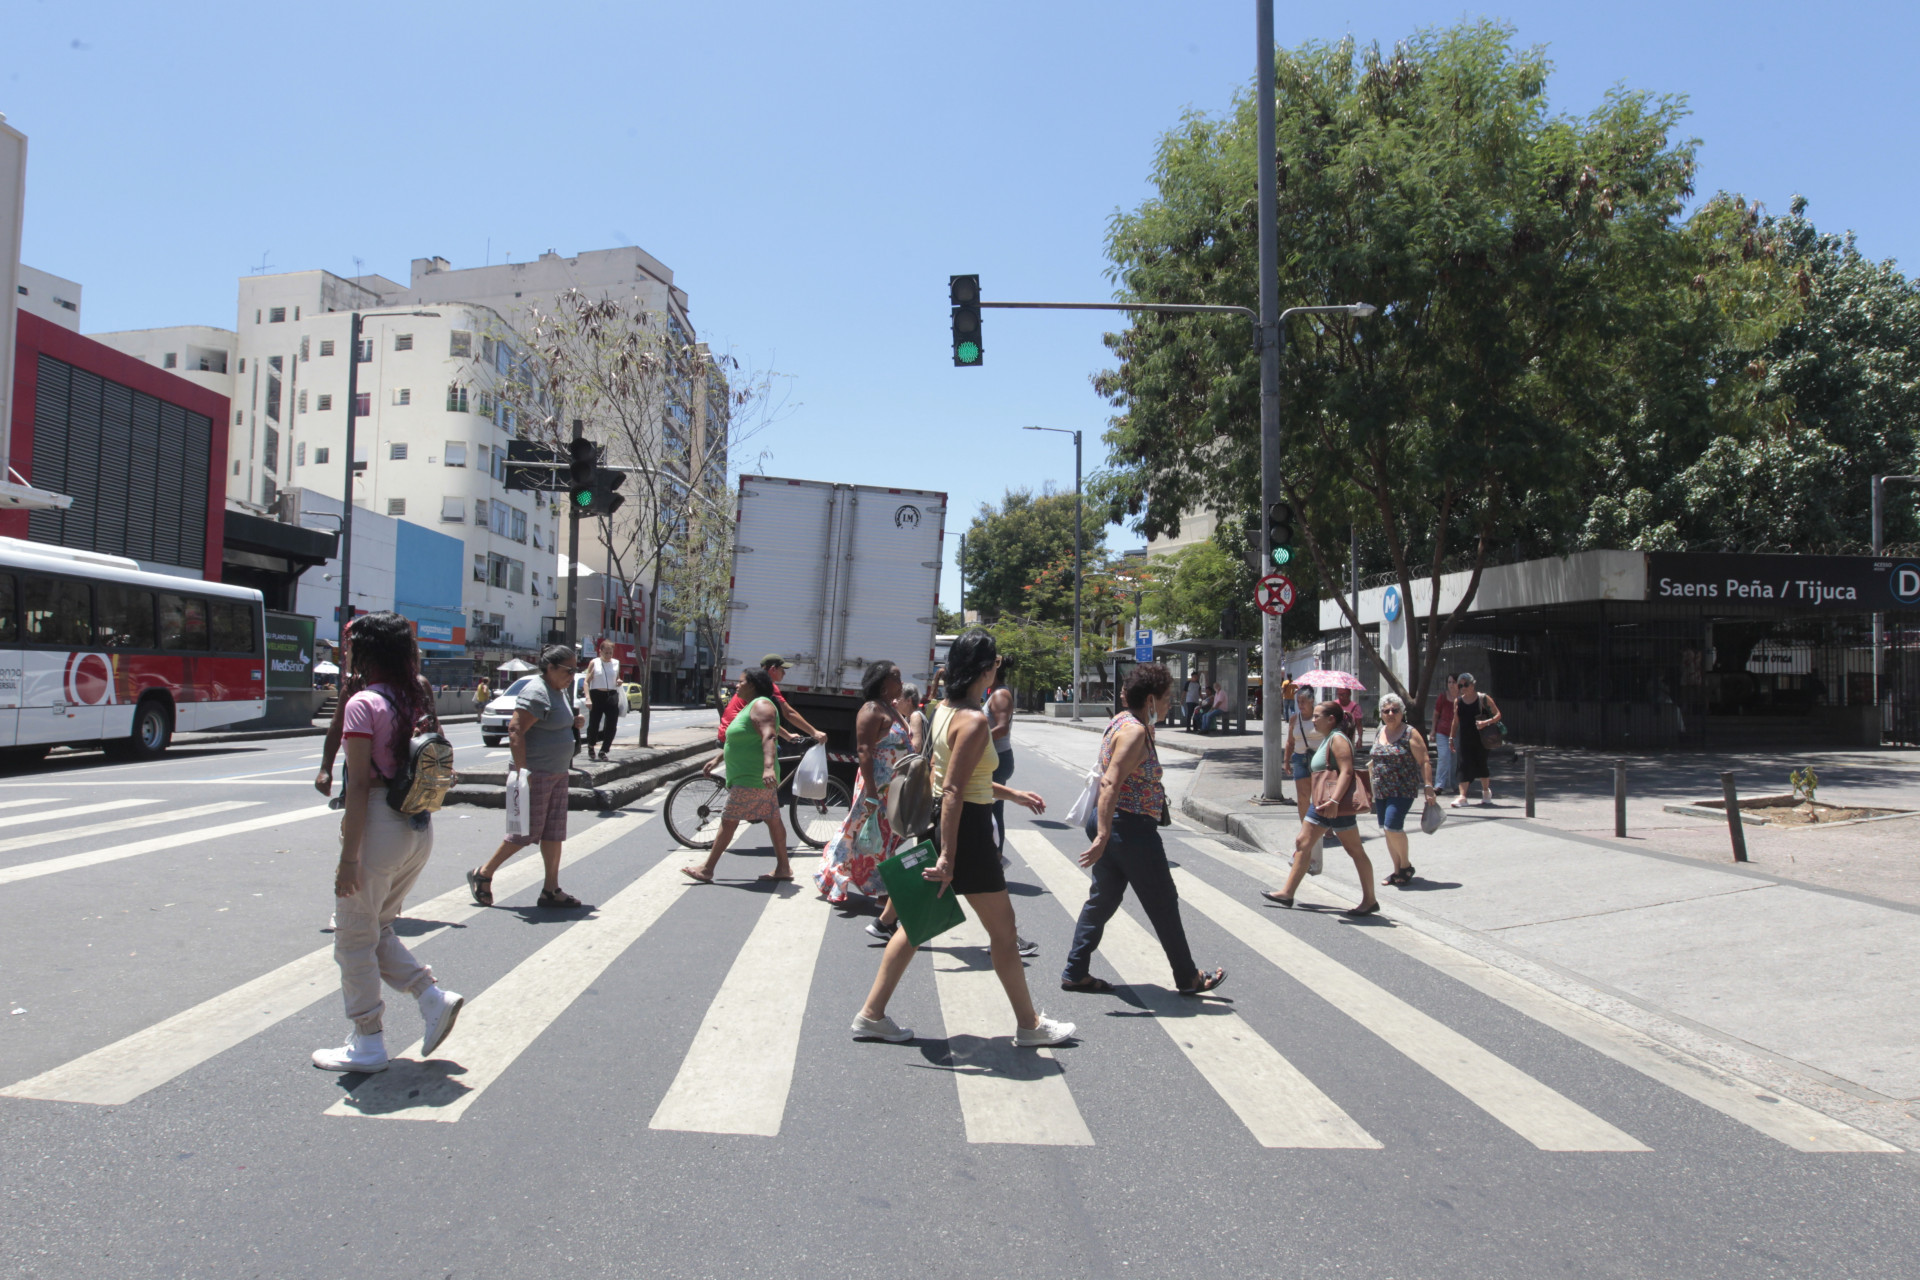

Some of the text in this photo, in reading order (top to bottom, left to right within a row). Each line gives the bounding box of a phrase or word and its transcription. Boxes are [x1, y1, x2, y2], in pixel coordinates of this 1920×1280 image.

[1659, 578, 1857, 605] Saens Peña / Tijuca
[1898, 570, 1920, 596] D
